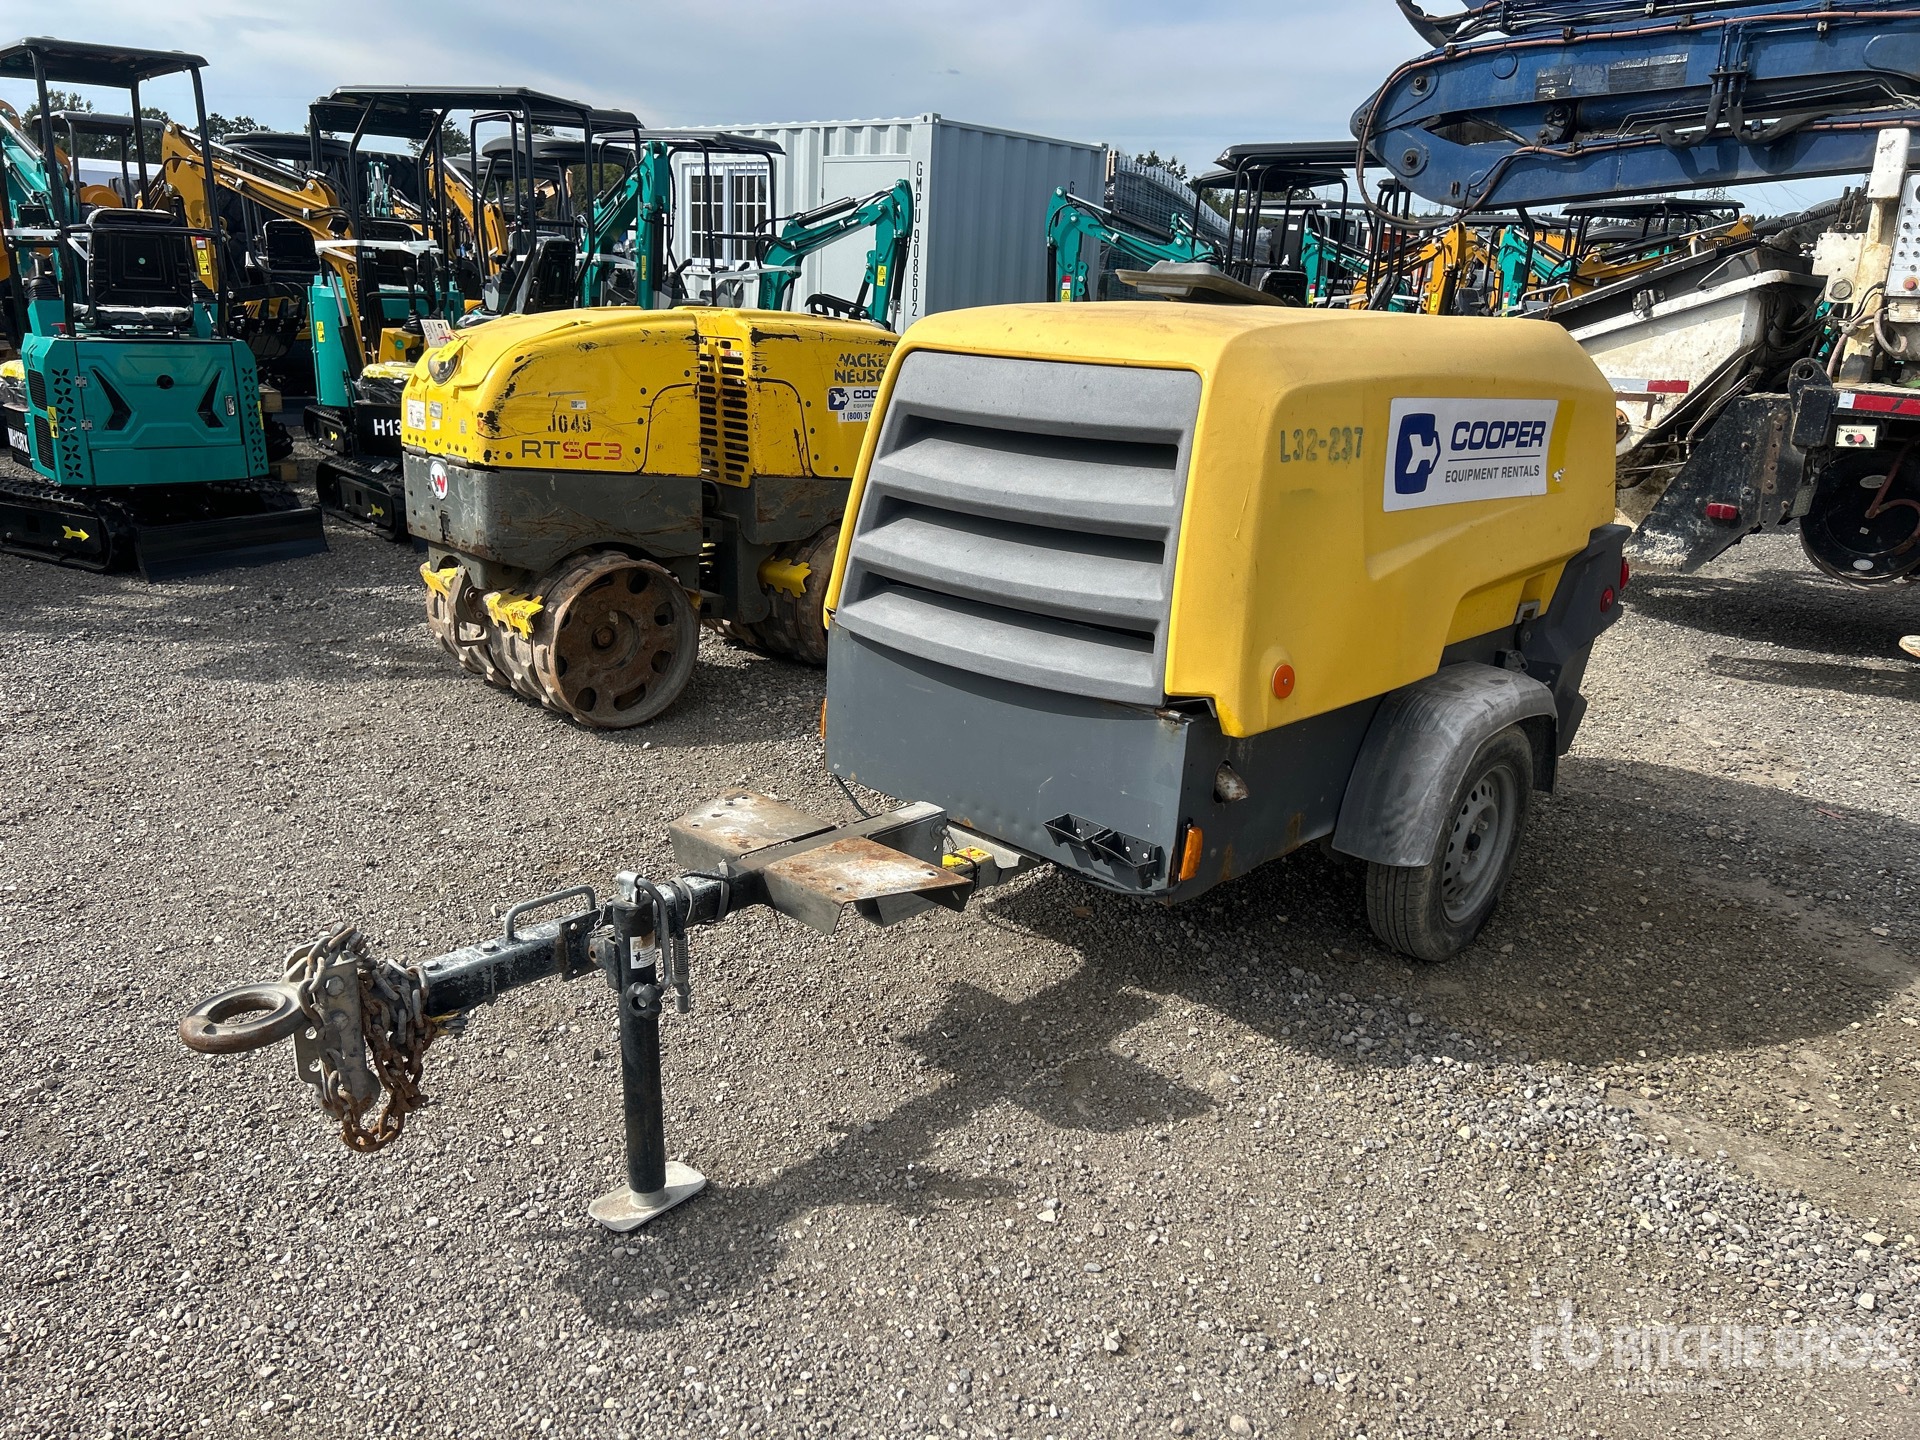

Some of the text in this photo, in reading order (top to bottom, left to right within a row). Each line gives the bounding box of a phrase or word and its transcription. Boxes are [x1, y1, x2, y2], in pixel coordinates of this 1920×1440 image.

[912, 161, 923, 317] GMPU 908602
[847, 411, 862, 421] (800)
[1450, 420, 1547, 451] COOPER
[1445, 464, 1540, 483] EQUIPMENT RENTALS
